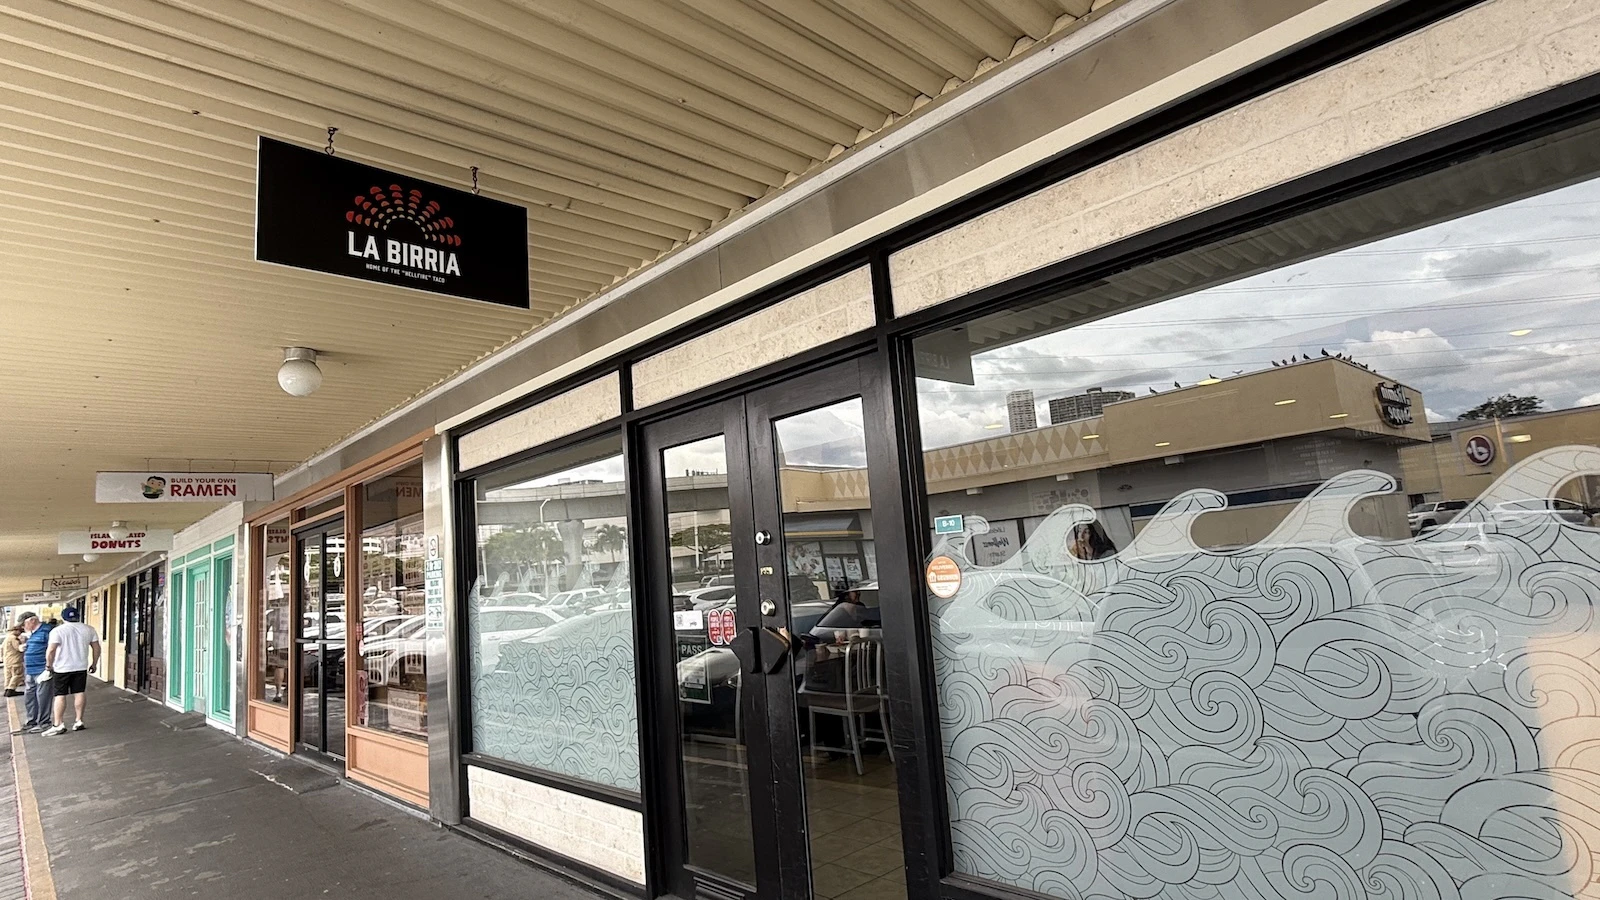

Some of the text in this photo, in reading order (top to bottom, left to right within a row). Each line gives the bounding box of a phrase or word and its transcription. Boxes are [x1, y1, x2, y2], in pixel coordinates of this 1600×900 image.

[348, 231, 461, 276] LA BIRRIA
[366, 263, 380, 271] HOME
[170, 484, 236, 496] RAMEN
[91, 540, 141, 549] DONUTS
[681, 644, 702, 655] PASS
